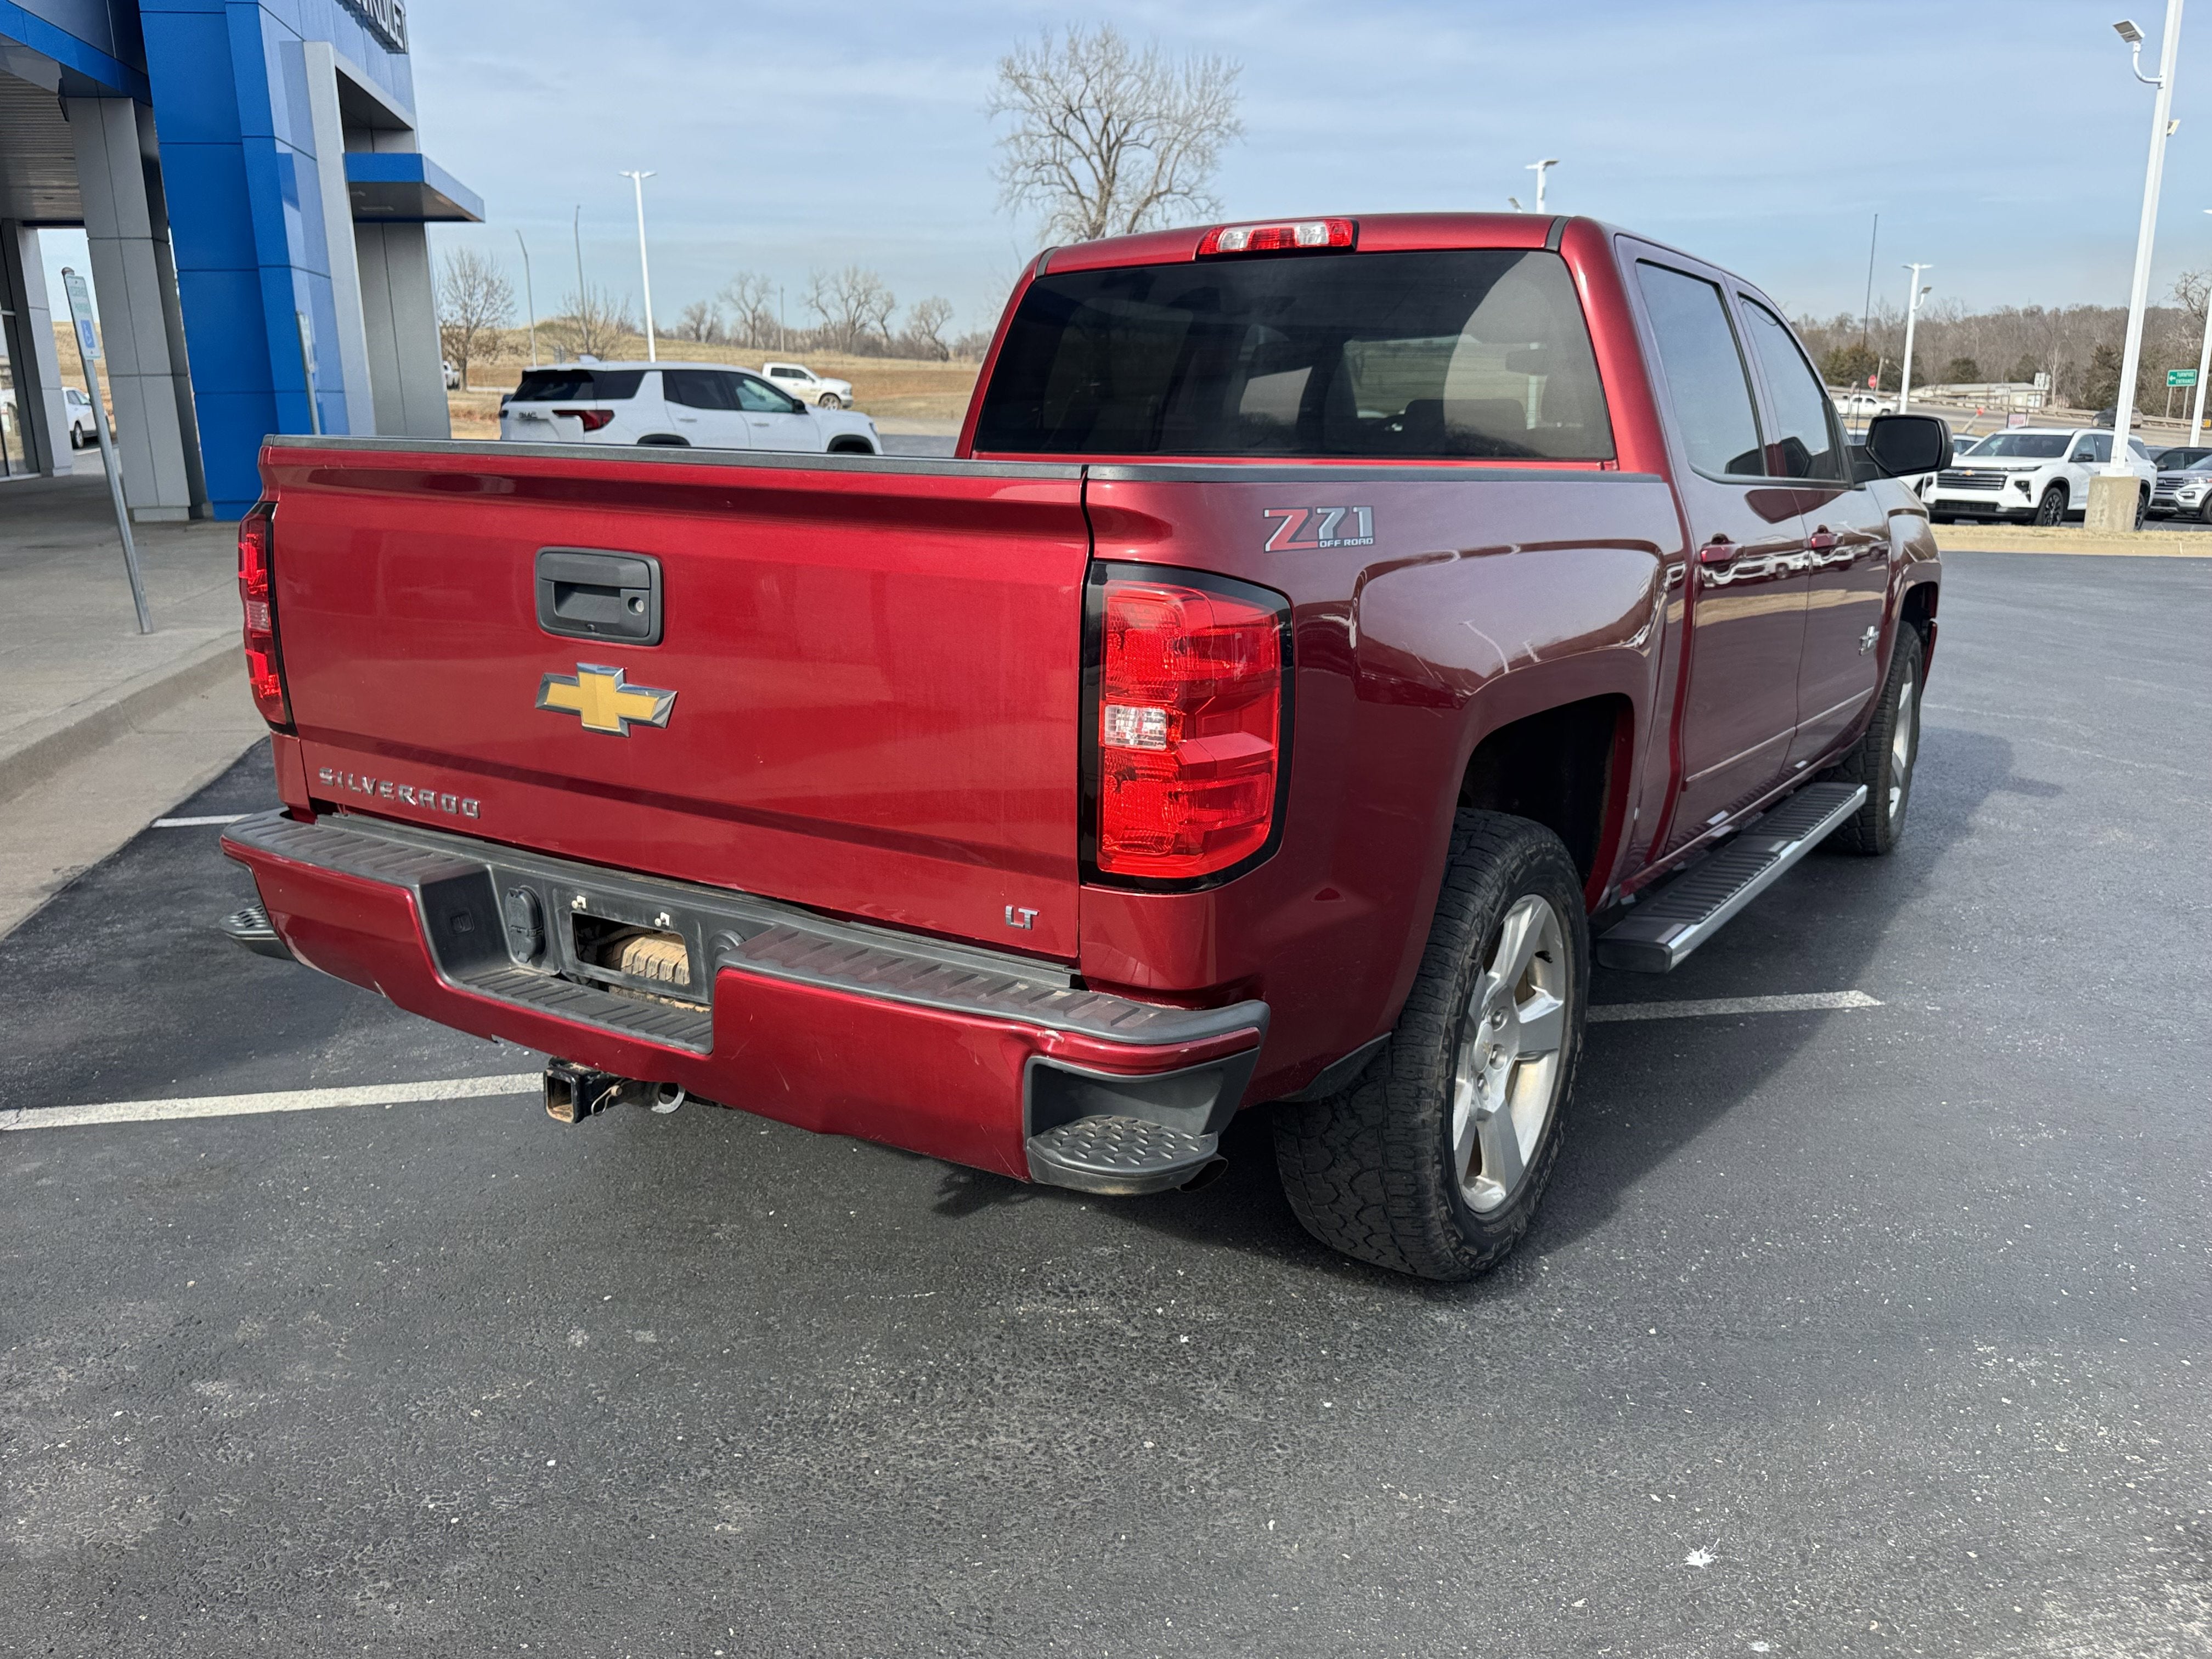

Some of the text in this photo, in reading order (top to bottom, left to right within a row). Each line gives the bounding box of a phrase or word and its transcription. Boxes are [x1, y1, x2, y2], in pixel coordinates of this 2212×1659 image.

[1263, 506, 1374, 552] Z71
[1319, 538, 1374, 548] OFF ROAD
[319, 768, 481, 819] SILVERADO
[1005, 905, 1039, 930] LT
